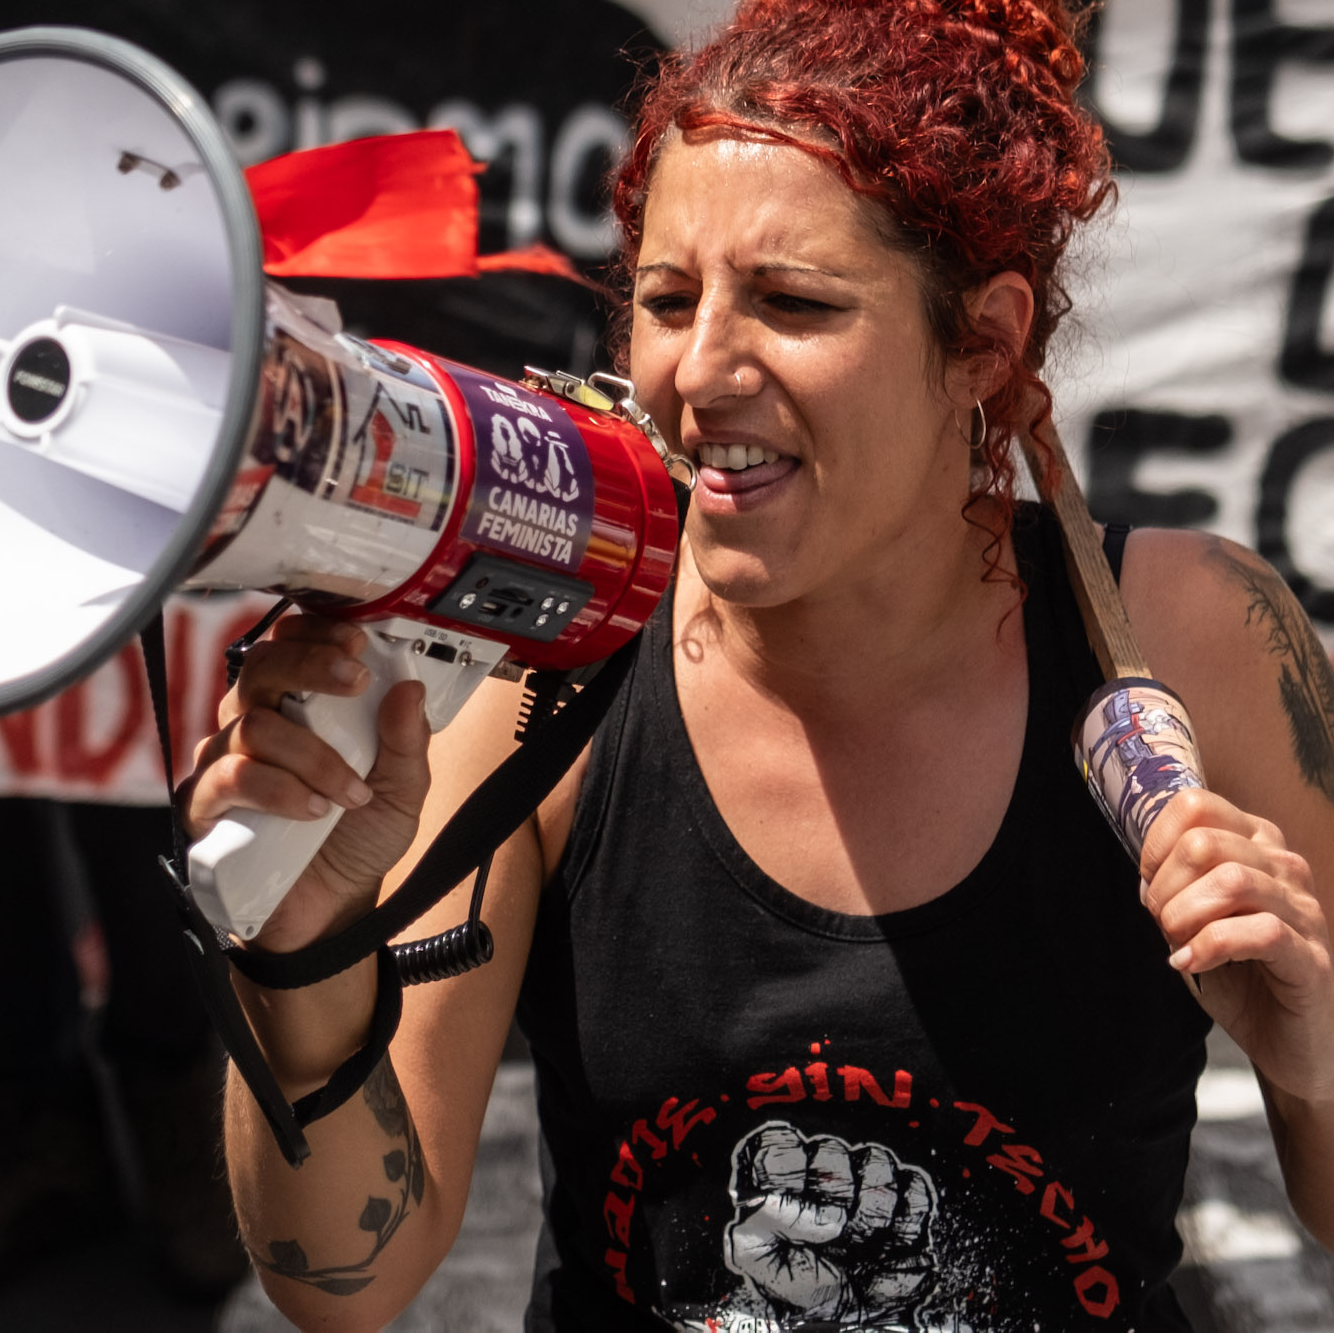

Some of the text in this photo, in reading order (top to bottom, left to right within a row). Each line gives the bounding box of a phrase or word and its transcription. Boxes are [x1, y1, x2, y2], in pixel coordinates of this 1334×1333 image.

[476, 512, 573, 565] FEMINISTA
[488, 486, 579, 538] CANARIAS
[953, 1099, 1121, 1319] TECHO
